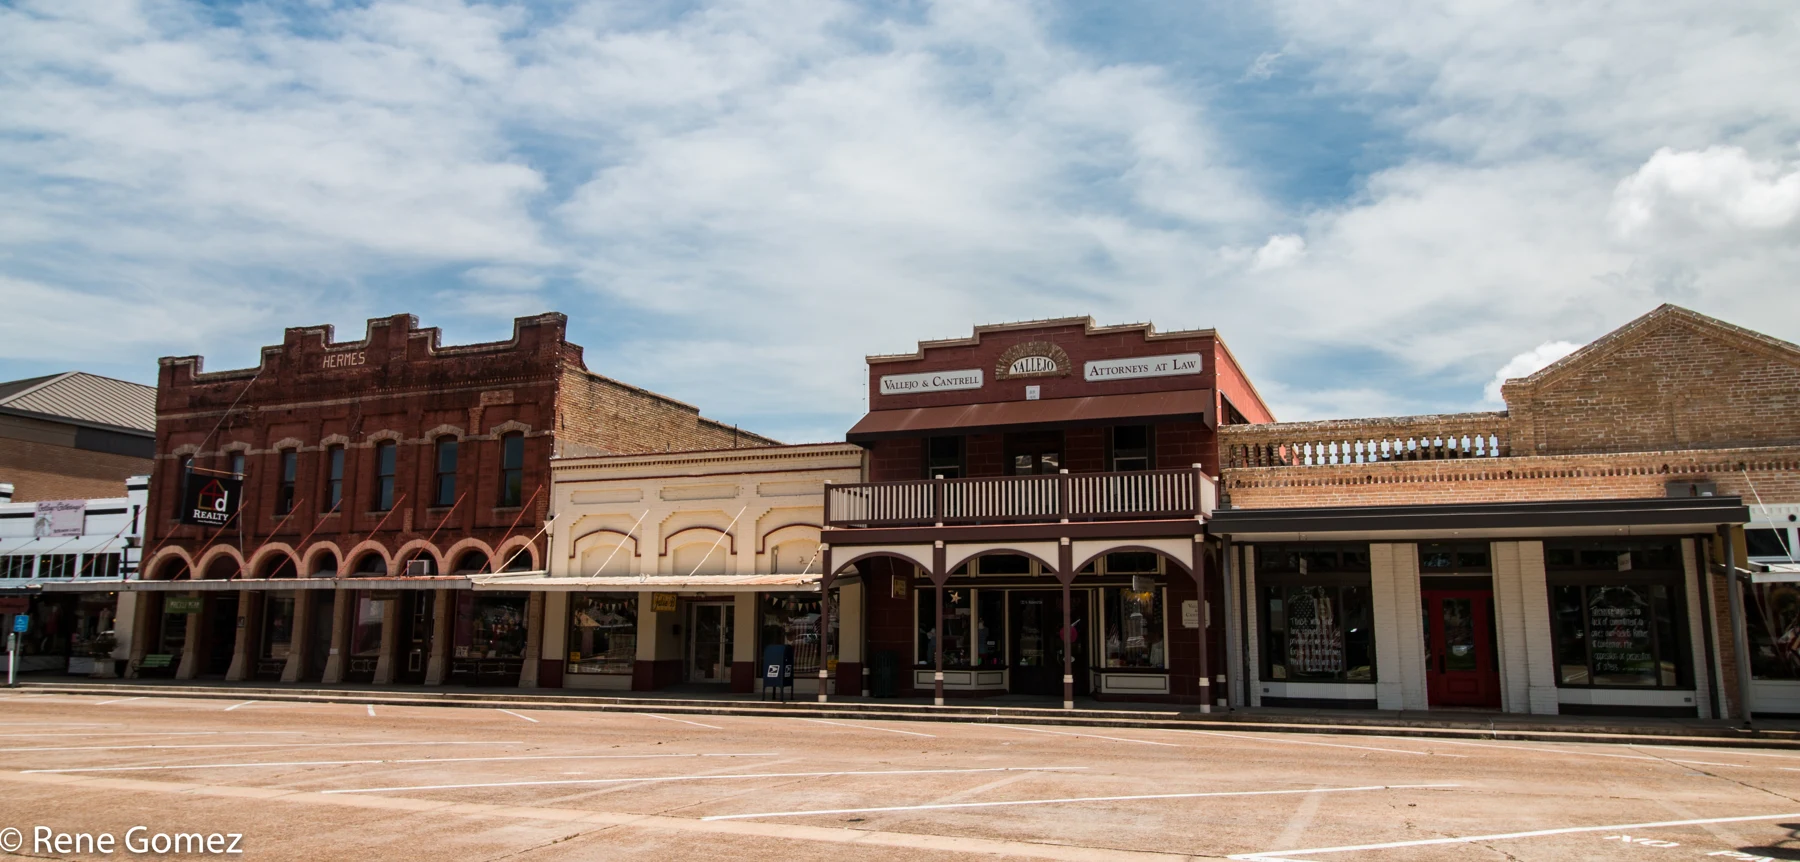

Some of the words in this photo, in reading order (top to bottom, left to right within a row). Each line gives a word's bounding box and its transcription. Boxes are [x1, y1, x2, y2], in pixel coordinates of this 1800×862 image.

[322, 351, 366, 369] HERMES
[1013, 357, 1054, 373] VALLEJO
[1089, 364, 1149, 376] ATTORNEYS
[1155, 362, 1168, 372] AT
[1173, 358, 1197, 371] LAW
[884, 379, 919, 390] VALLEJO
[922, 379, 929, 388] &
[932, 376, 980, 387] CANTRELL
[192, 509, 230, 522] REALTY
[1603, 834, 1681, 849] NO
